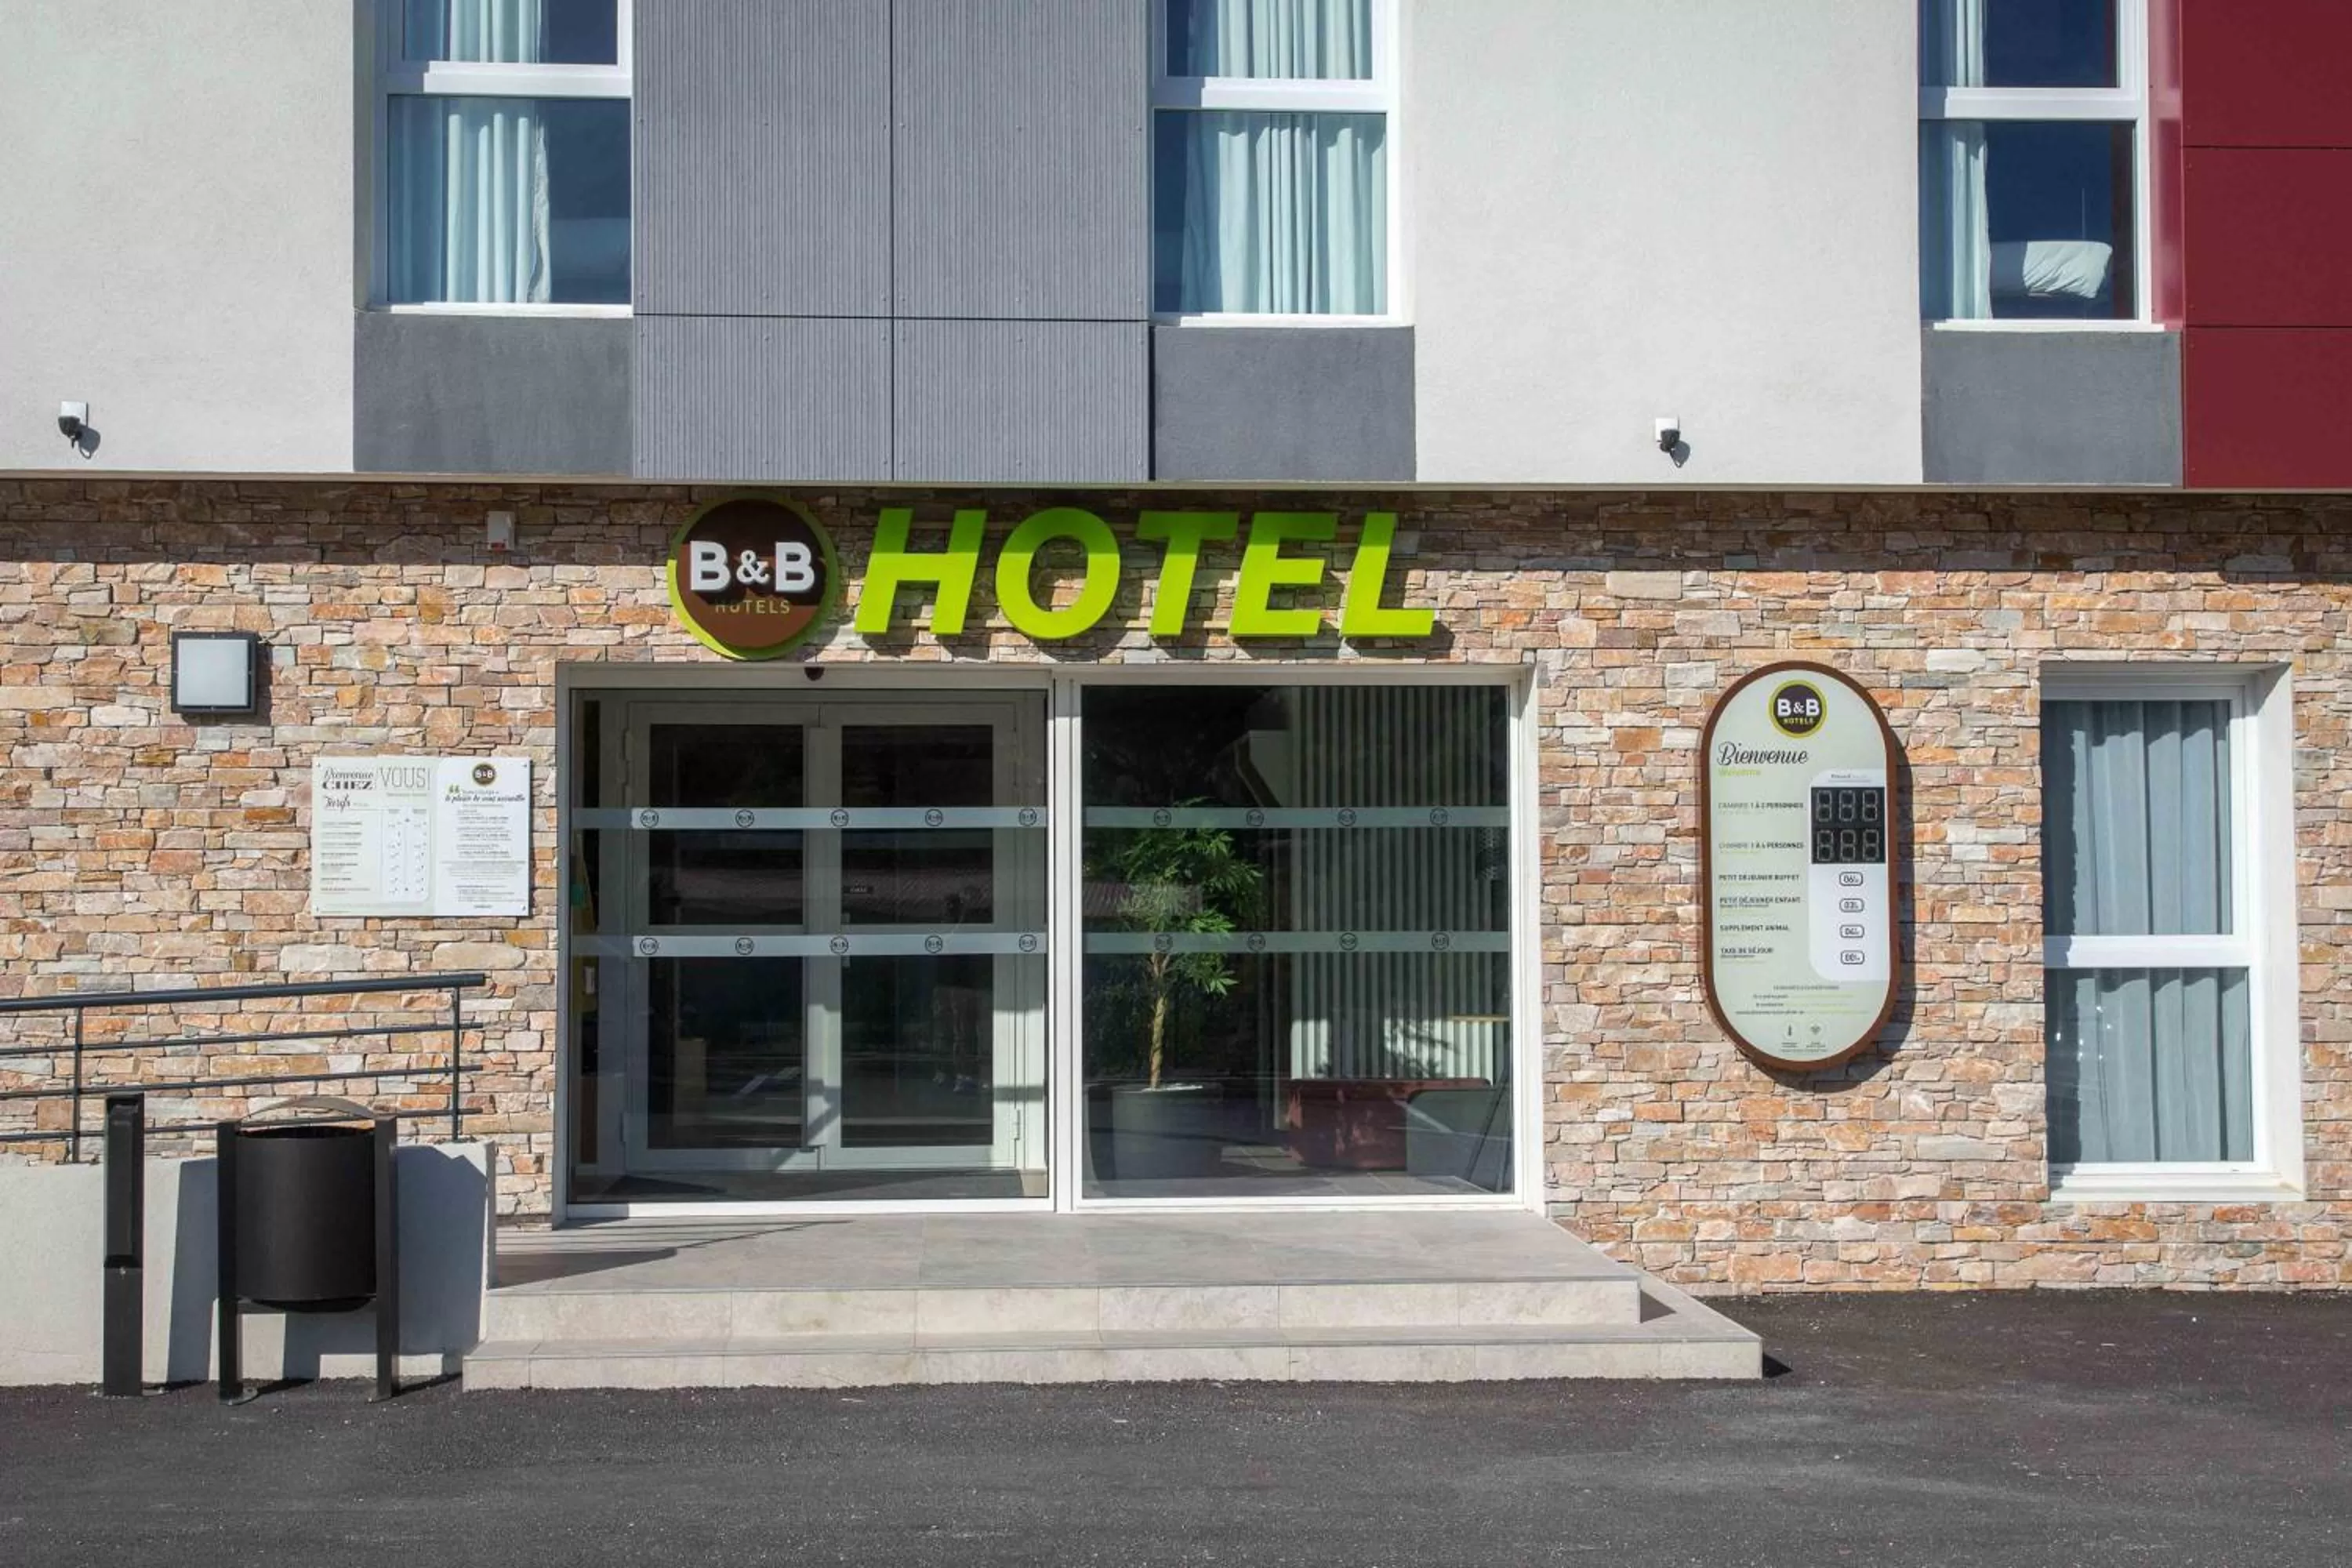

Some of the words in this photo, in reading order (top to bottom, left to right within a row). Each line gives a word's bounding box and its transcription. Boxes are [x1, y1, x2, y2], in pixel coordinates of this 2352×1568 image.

[690, 540, 815, 592] B&B
[855, 507, 1436, 639] HOTEL
[714, 599, 791, 615] HOTELS
[1777, 698, 1820, 717] B&B
[1717, 741, 1809, 766] Bienvenue
[322, 780, 374, 790] CHEZ
[379, 767, 426, 789] VOUS
